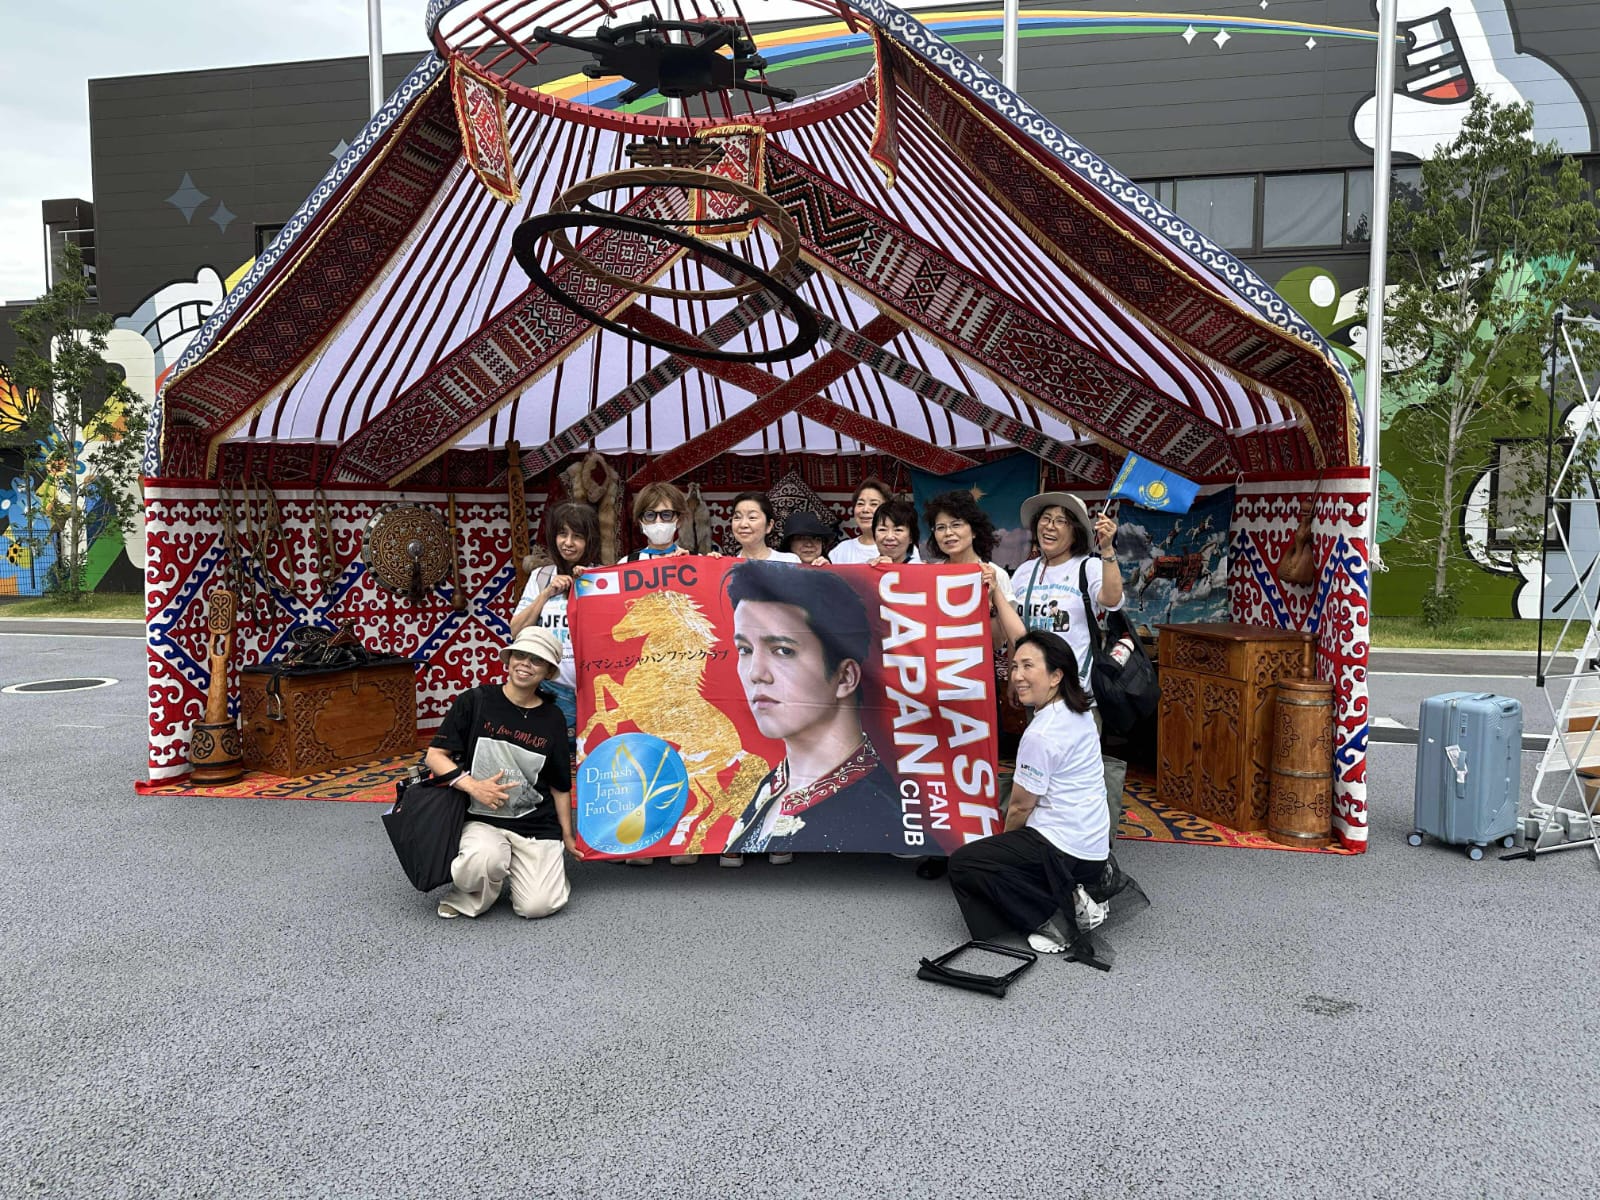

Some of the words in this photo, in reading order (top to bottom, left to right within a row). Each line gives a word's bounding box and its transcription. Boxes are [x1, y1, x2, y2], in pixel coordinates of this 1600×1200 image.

[623, 564, 698, 591] DJFC
[879, 571, 945, 775] JAPAN
[935, 571, 999, 844] DIMASH
[585, 766, 633, 783] Dimash
[594, 782, 629, 801] Japan
[900, 780, 924, 847] CLUB
[926, 781, 951, 830] FAN
